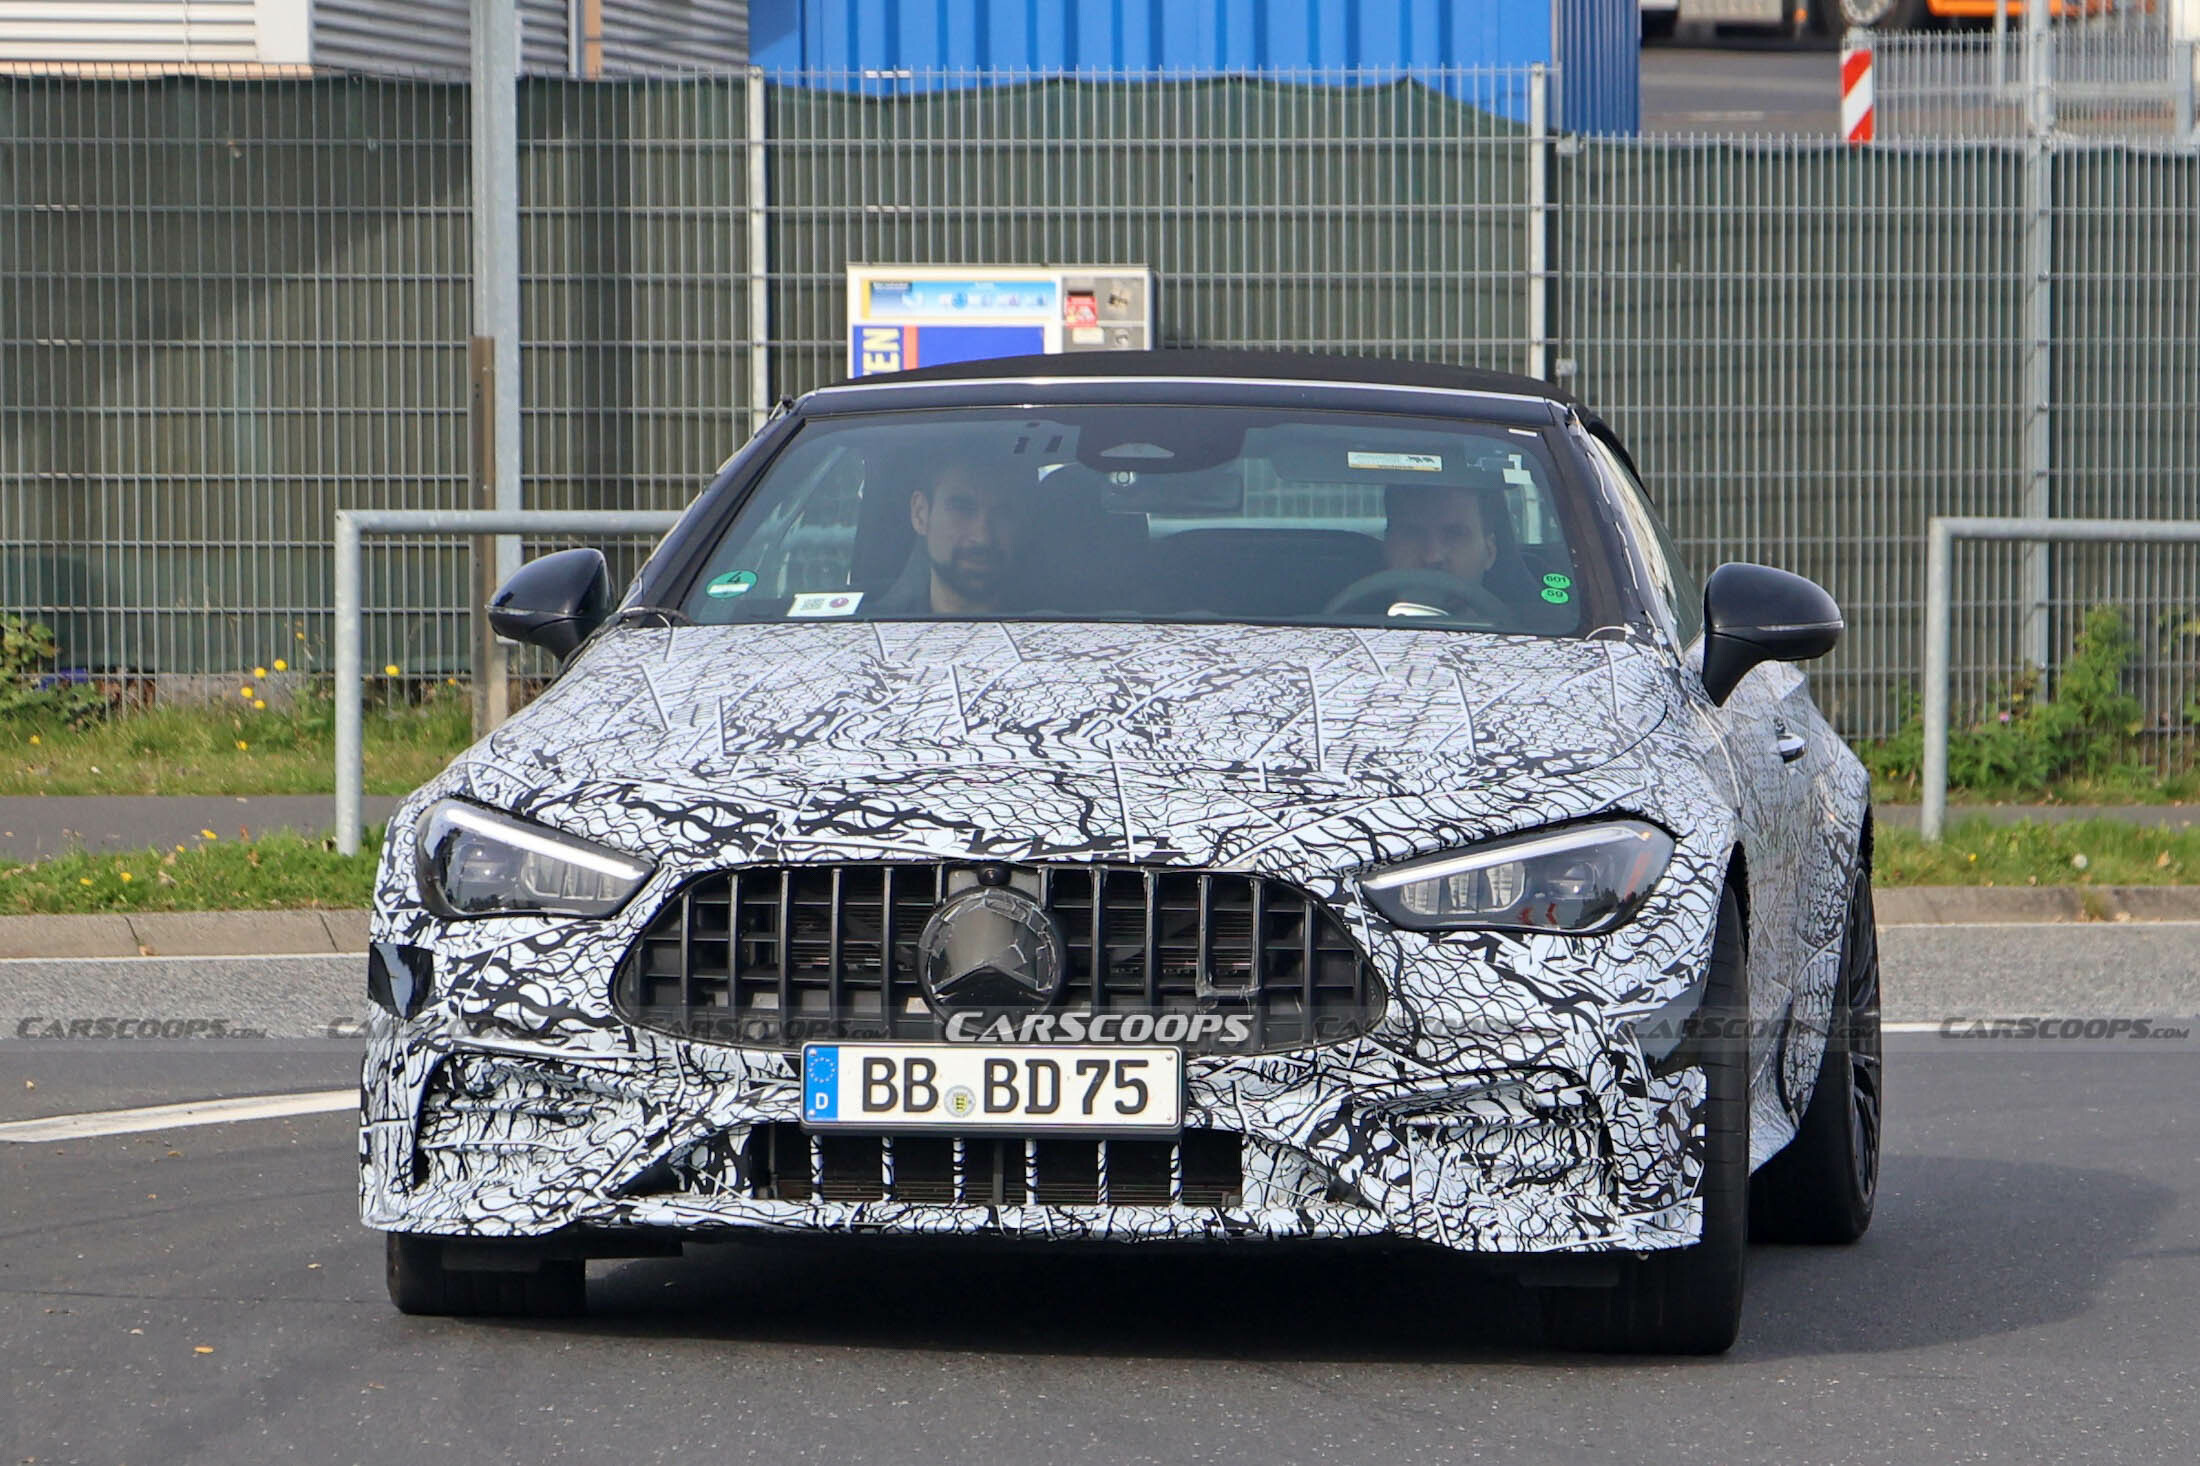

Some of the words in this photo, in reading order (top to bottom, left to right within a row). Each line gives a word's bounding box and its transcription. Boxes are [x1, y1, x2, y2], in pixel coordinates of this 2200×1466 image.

[862, 328, 900, 376] EN
[727, 571, 742, 584] 4
[815, 1091, 829, 1110] D
[862, 1056, 940, 1113] BB
